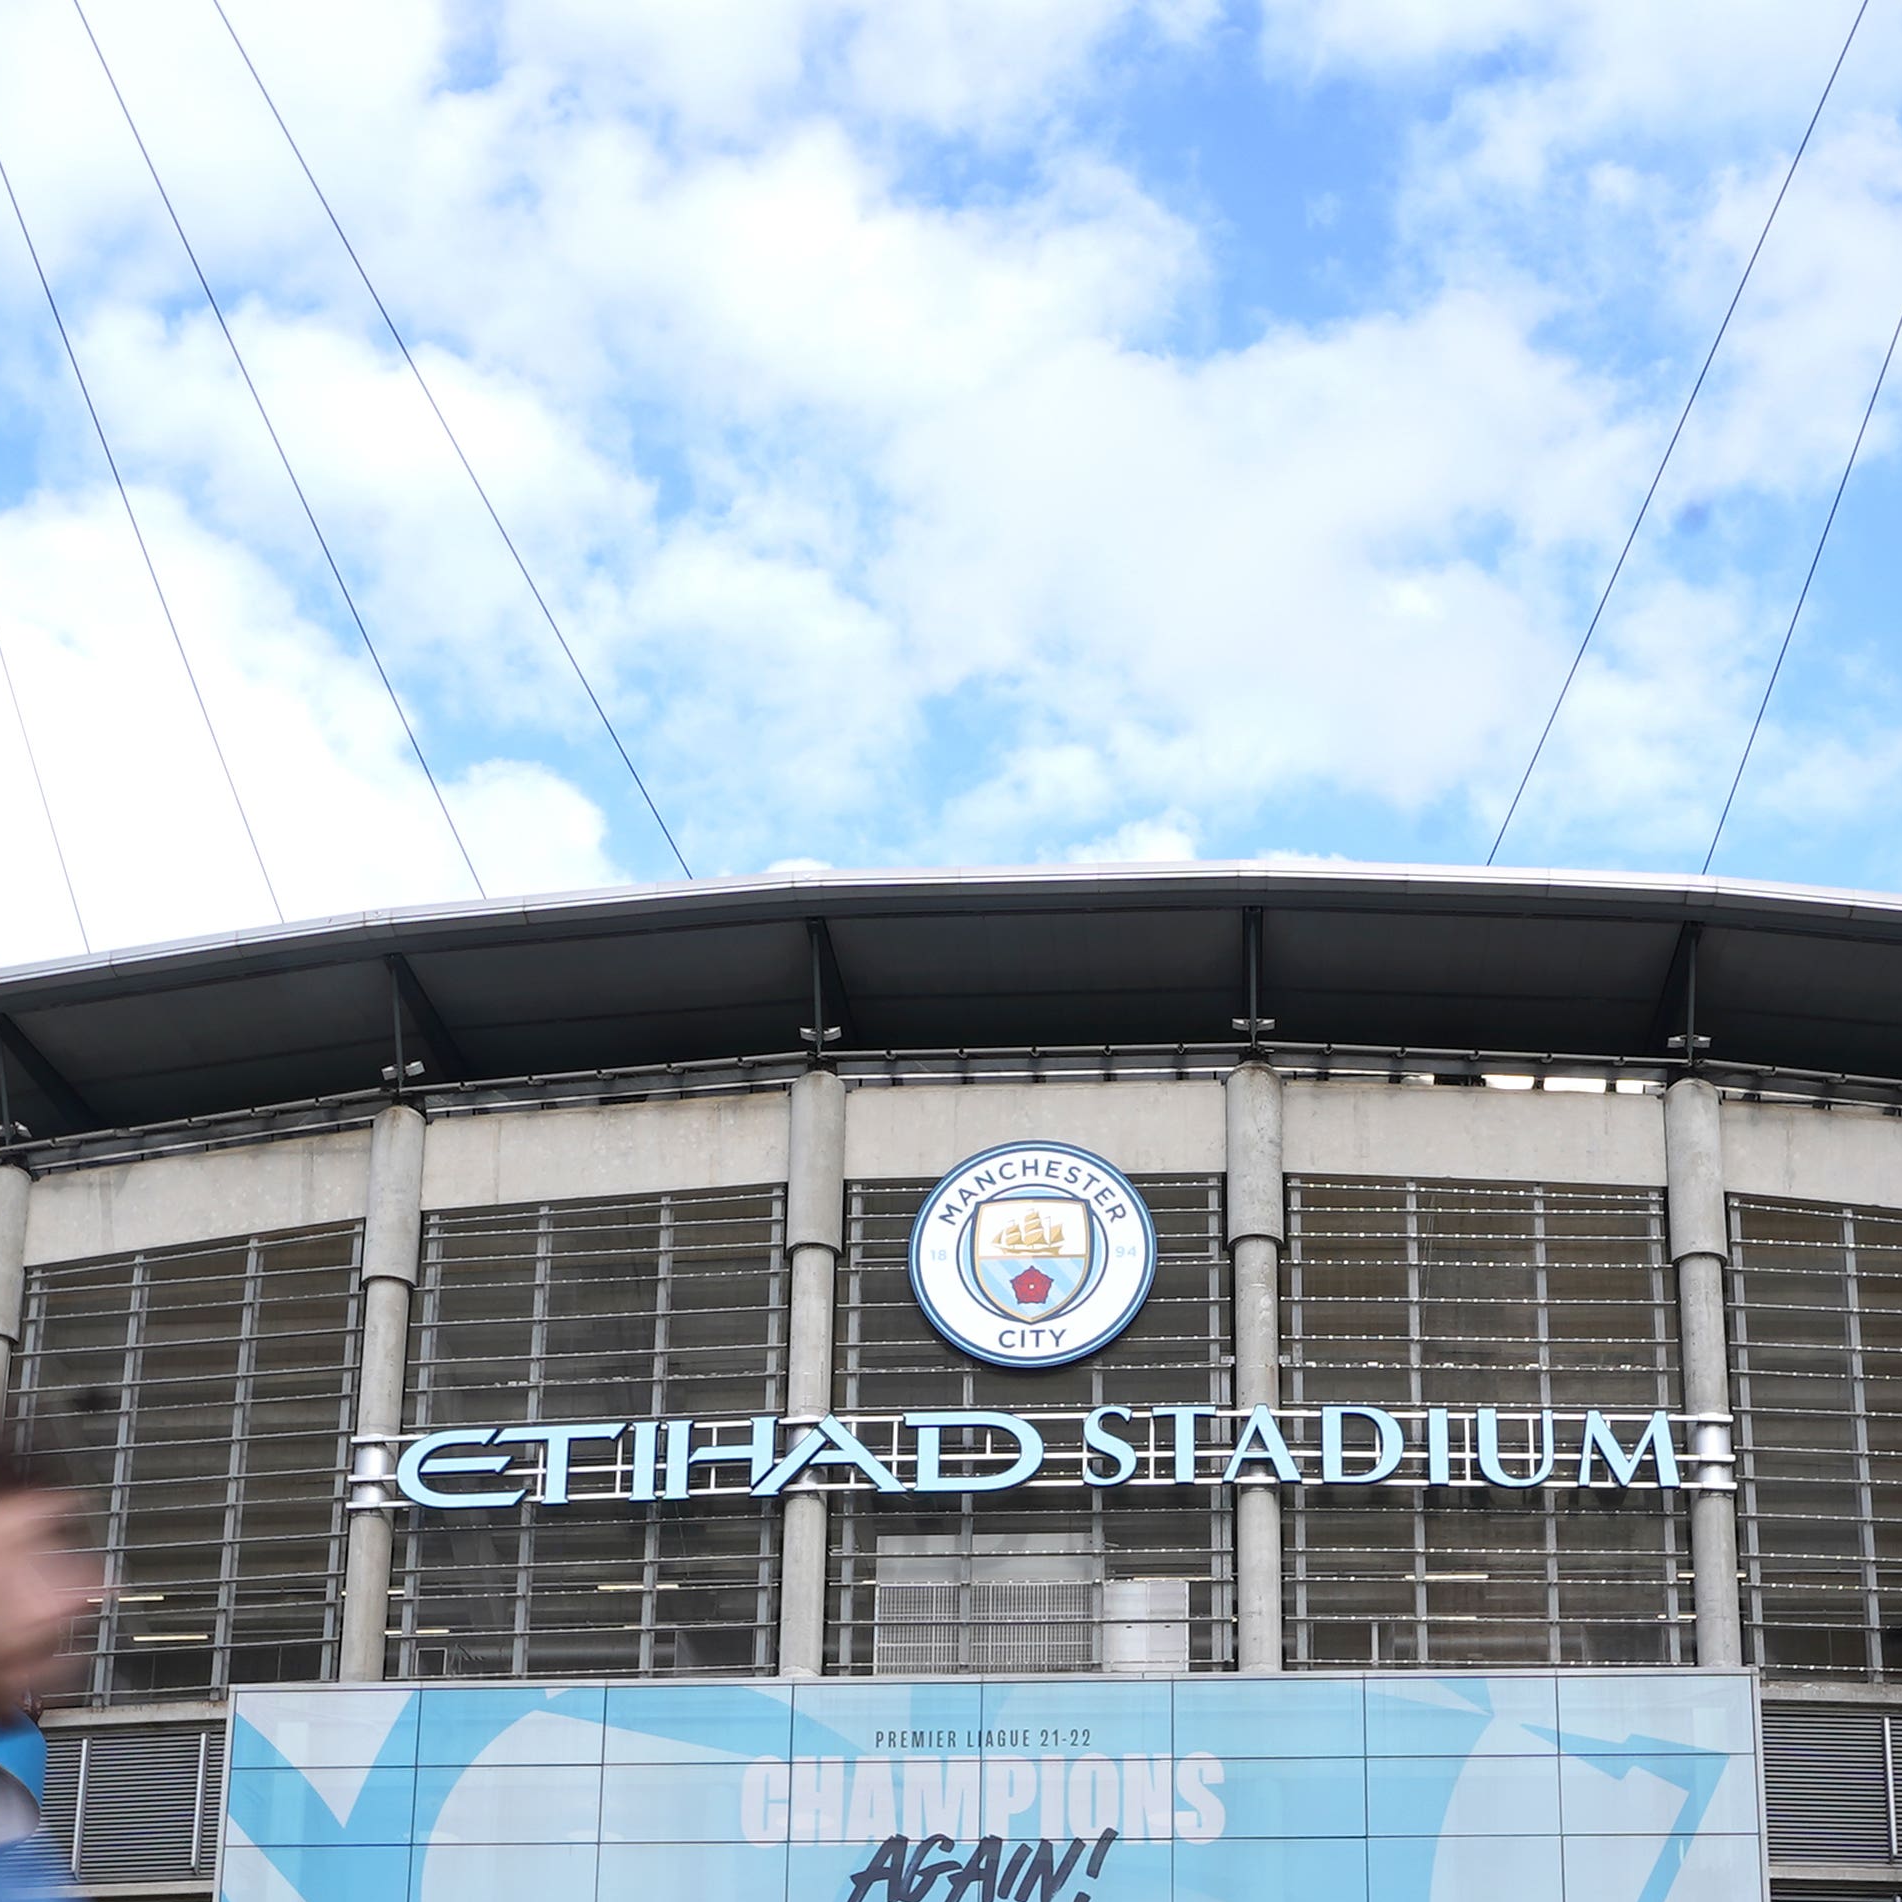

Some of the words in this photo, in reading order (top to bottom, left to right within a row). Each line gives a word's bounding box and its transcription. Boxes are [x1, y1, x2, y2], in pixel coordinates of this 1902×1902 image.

[938, 1158, 1127, 1226] MANCHESTER
[930, 1249, 947, 1262] 18
[1114, 1245, 1137, 1259] 94
[998, 1328, 1067, 1349] CITY
[397, 1410, 1045, 1510] ETIHAD
[1081, 1403, 1682, 1490] STADIUM
[874, 1729, 958, 1749] PREMIER
[1039, 1727, 1092, 1748] 21-22
[739, 1750, 1227, 1849] CHAMPIONS
